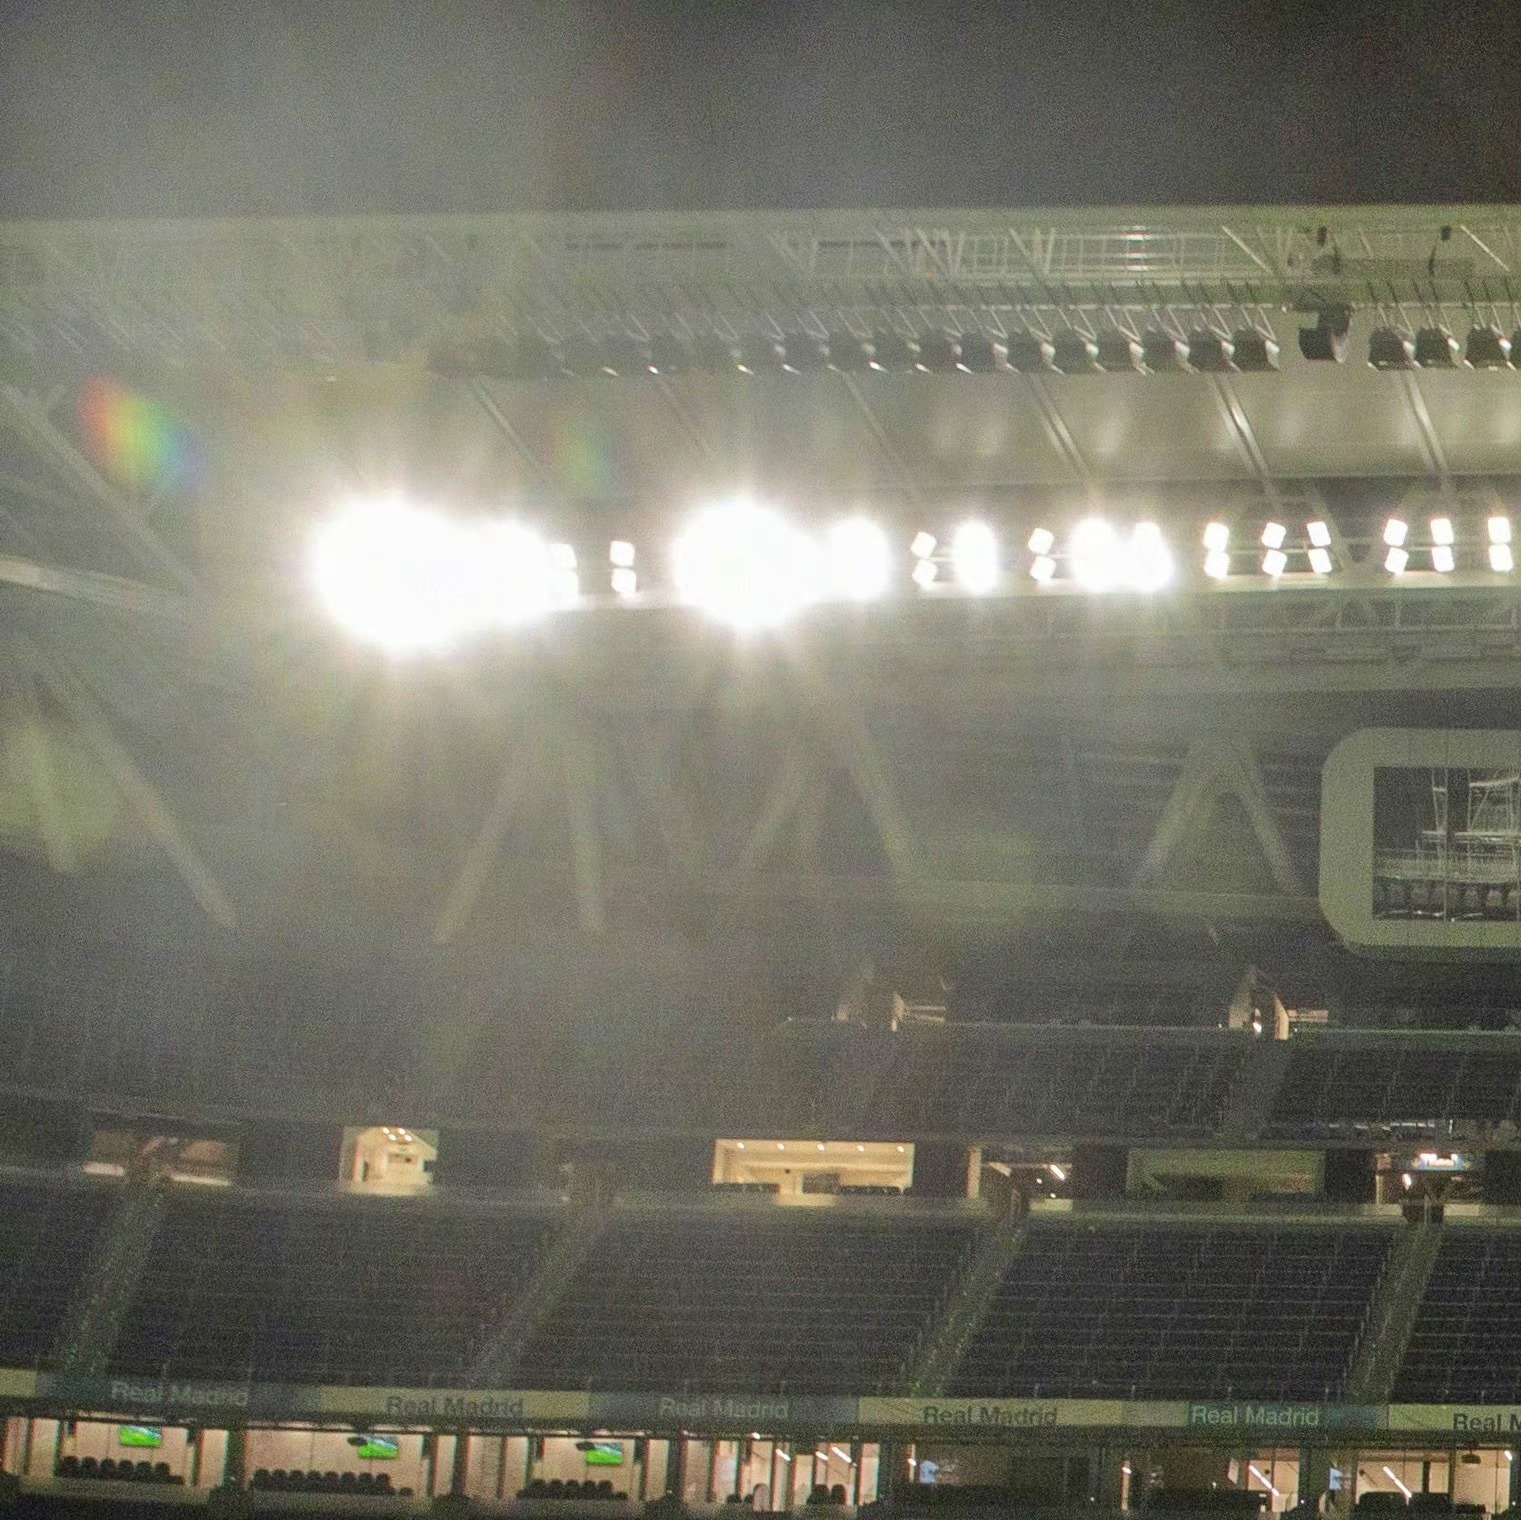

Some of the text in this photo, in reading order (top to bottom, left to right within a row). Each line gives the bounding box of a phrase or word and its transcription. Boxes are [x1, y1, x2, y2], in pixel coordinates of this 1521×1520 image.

[387, 1396, 436, 1415] Real
[923, 1406, 1057, 1424] Real Madrid
[1191, 1406, 1319, 1425] Real Madrid
[1453, 1414, 1501, 1431] Real
